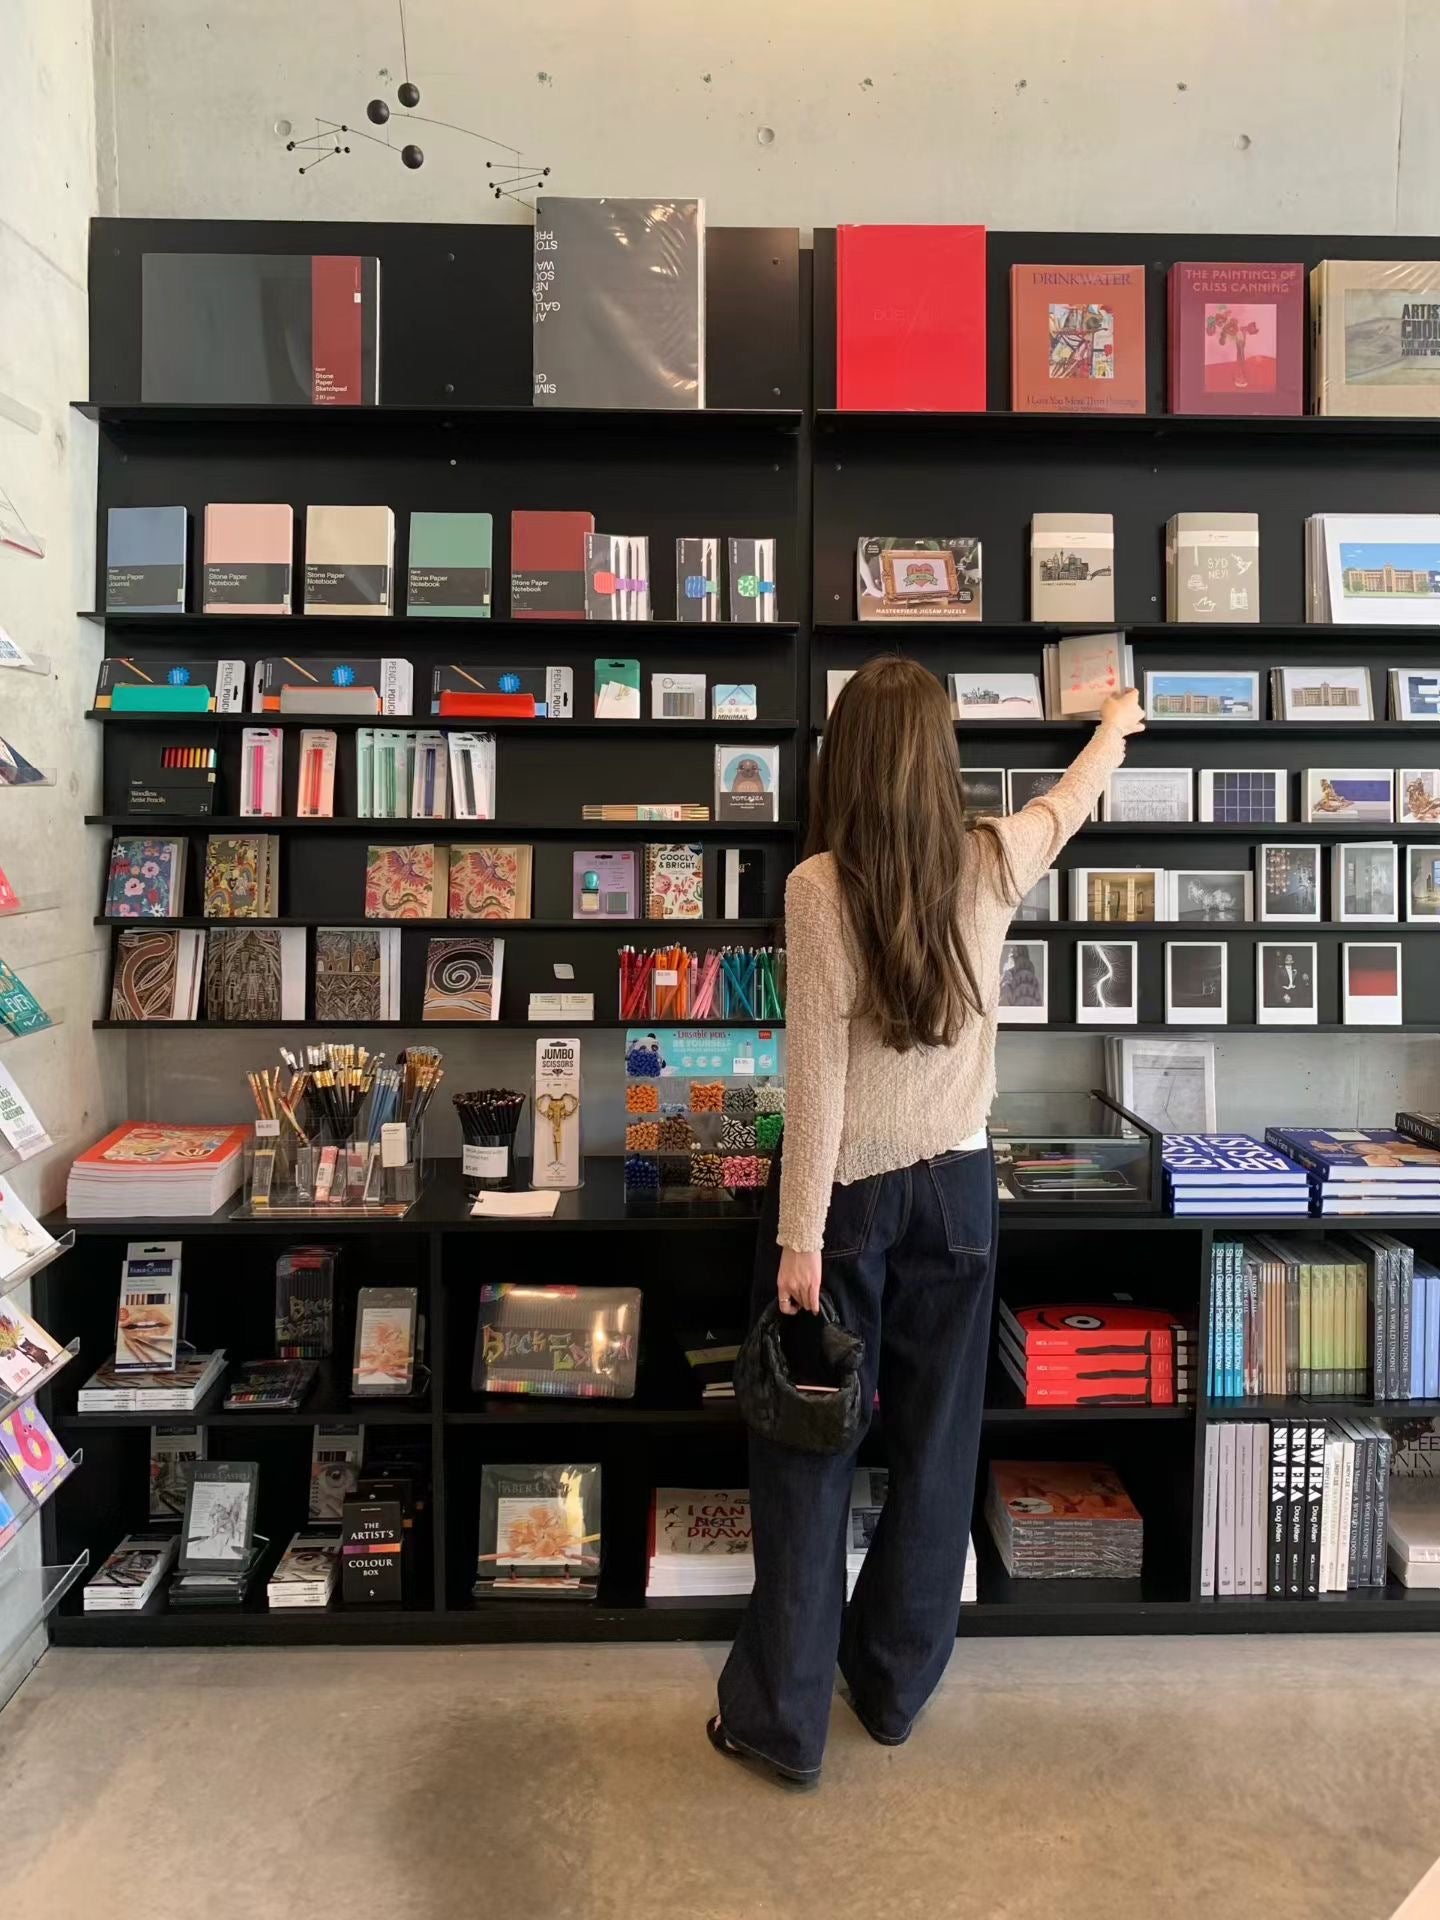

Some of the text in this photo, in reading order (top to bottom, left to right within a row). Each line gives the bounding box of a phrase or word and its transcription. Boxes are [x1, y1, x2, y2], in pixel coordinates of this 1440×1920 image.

[1032, 272, 1132, 286] DRINKWATER
[1184, 270, 1297, 280] THE PAINTINGS OF
[1192, 282, 1289, 293] CRISS CANNING
[1402, 320, 1440, 340] CHOI
[1208, 558, 1228, 568] SYD
[224, 662, 233, 686] PENCIL
[388, 661, 396, 715] PENCIL POUCH
[6, 994, 34, 1012] EVER
[678, 1030, 726, 1040] Erasable pens
[542, 1048, 574, 1059] JUMBO
[1266, 1132, 1279, 1146] About
[1398, 1116, 1434, 1141] EXPOSURE
[1216, 1248, 1224, 1273] Shaun
[1225, 1248, 1234, 1273] Shaun
[1235, 1248, 1243, 1273] Shaun
[1215, 1308, 1224, 1332] Pacific
[1225, 1308, 1233, 1332] Pacific
[1234, 1308, 1243, 1332] Pacific
[1215, 1333, 1224, 1370] Undertow
[1224, 1333, 1233, 1370] Undertow
[1234, 1333, 1243, 1370] Undertow
[1273, 1428, 1287, 1464] NEW
[1292, 1428, 1306, 1464] NEW
[1310, 1428, 1325, 1464] NEW
[1272, 1466, 1286, 1502] ERA
[1291, 1466, 1305, 1502] ERA
[1309, 1466, 1323, 1502] ERA
[687, 1505, 745, 1517] I CAN
[1275, 1506, 1283, 1522] Doug
[1293, 1506, 1301, 1522] Doug
[1311, 1506, 1319, 1522] Doug
[350, 1530, 394, 1541] ARTIST'S
[688, 1527, 752, 1538] DRAW
[349, 1559, 393, 1568] COLOUR
